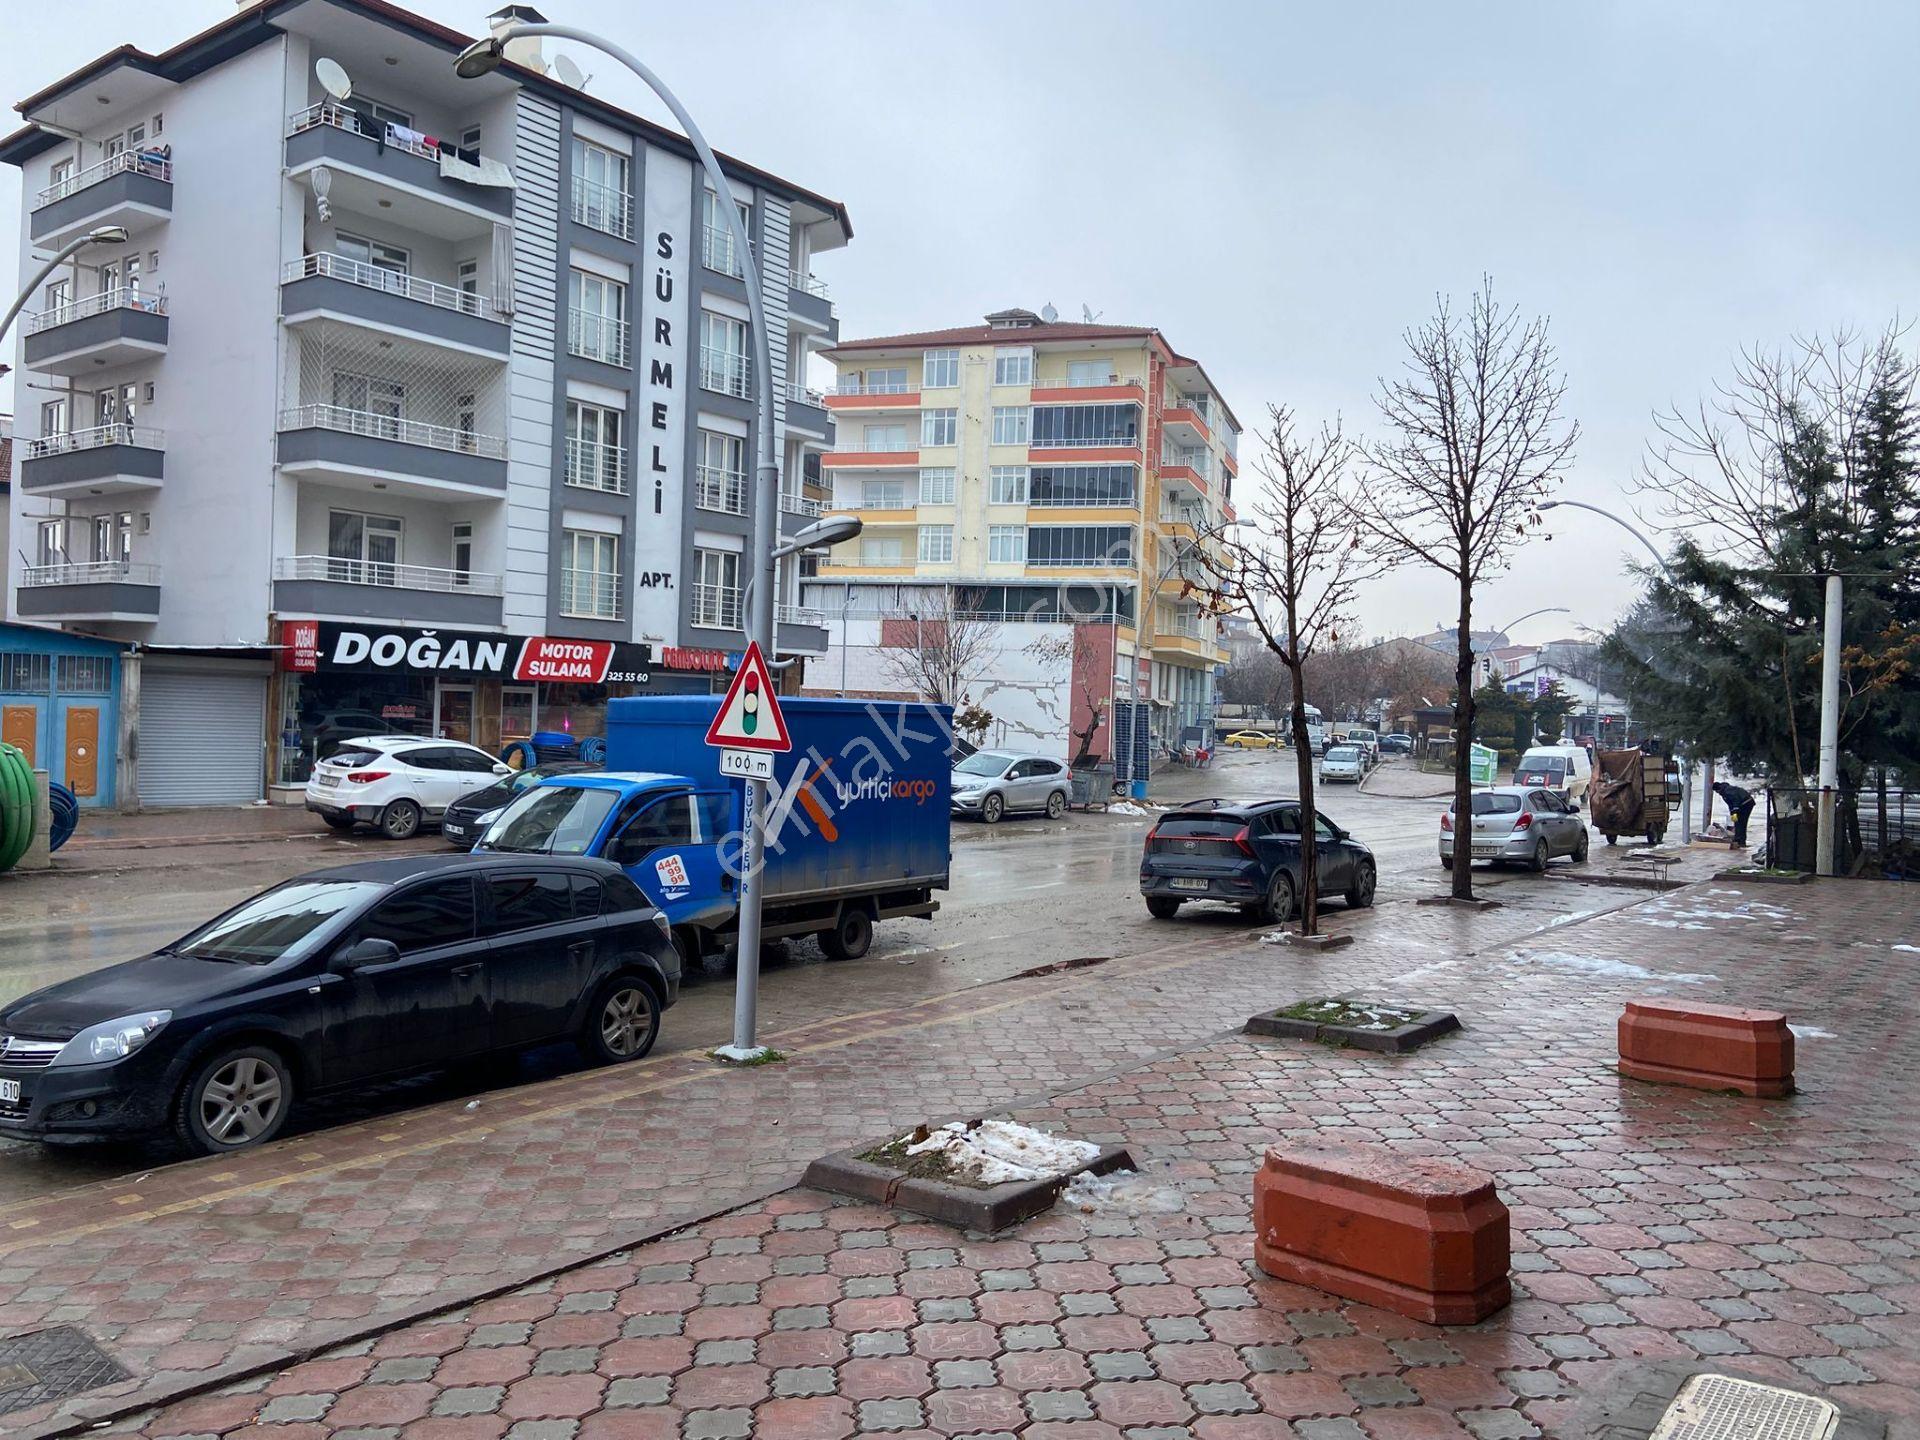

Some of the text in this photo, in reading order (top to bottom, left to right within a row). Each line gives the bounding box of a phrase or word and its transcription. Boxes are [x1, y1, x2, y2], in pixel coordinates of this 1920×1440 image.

[651, 231, 674, 515] SÜRMELİ
[640, 571, 674, 589] APT.
[332, 629, 507, 672] DOĞAN
[540, 643, 593, 660] MOTOR
[528, 661, 592, 678] SULAMA
[607, 671, 648, 683] 325 55 60
[727, 755, 767, 772] 100 m
[658, 857, 678, 871] 444
[667, 865, 681, 877] 99
[670, 874, 685, 885] 99
[3, 1081, 19, 1099] 610
